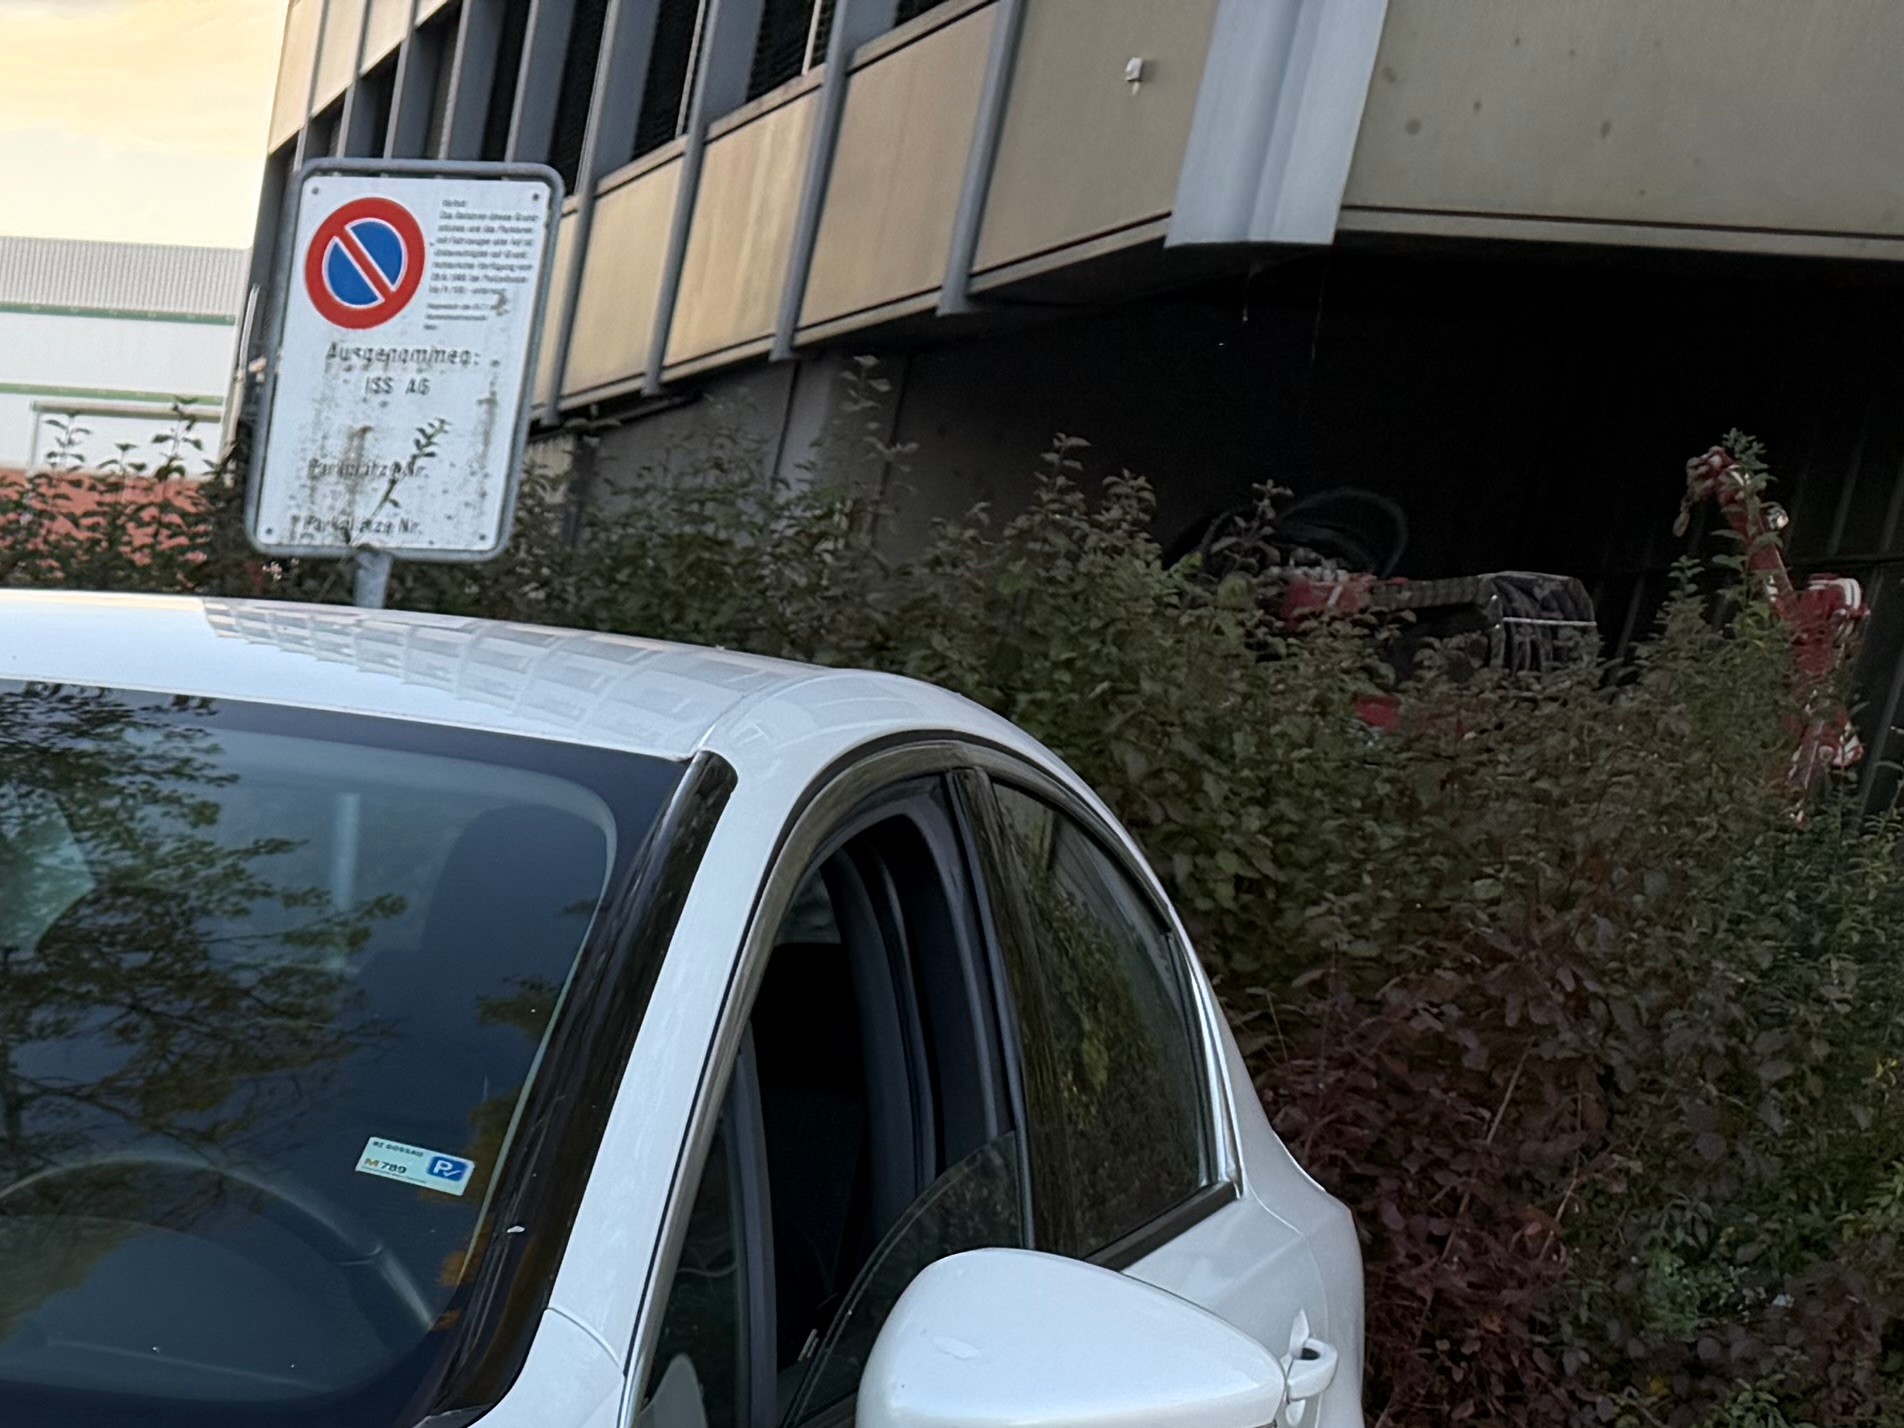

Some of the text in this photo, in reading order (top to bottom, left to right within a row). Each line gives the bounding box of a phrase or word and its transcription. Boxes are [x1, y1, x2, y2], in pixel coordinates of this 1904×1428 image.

[364, 376, 431, 395] ISS AG
[381, 1161, 408, 1174] 789
